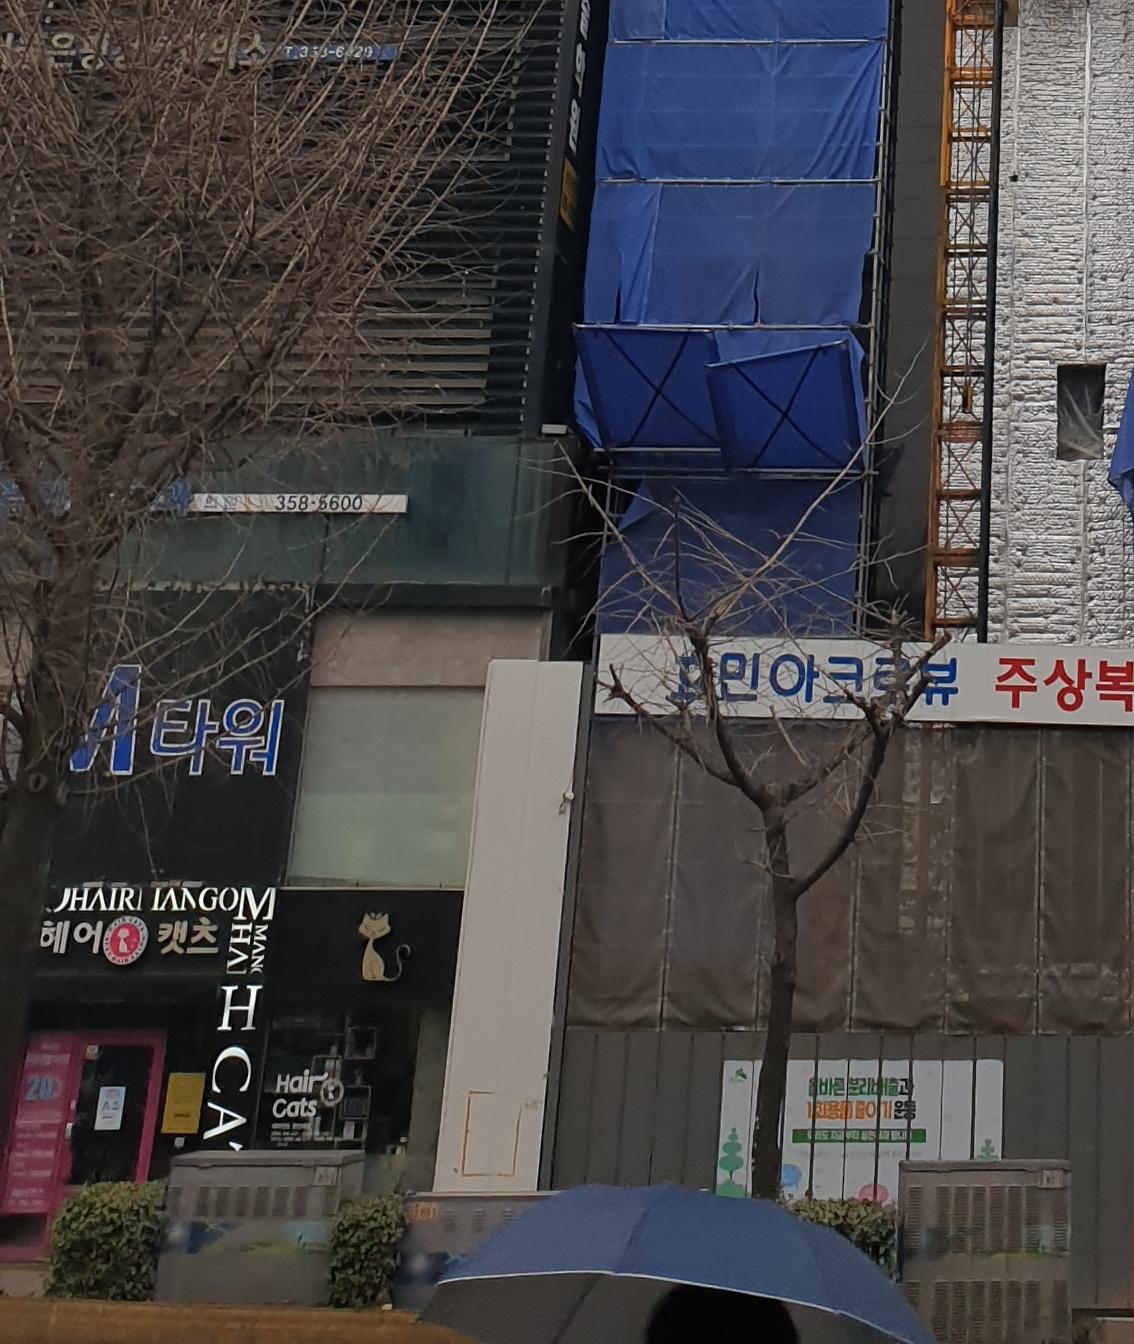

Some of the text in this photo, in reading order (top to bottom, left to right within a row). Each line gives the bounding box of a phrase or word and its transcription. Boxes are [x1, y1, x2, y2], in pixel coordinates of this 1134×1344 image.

[40, 920, 103, 954] 헤어
[157, 916, 220, 954] 캣츠
[275, 1069, 329, 1093] Hair
[272, 1097, 318, 1118] Cats
